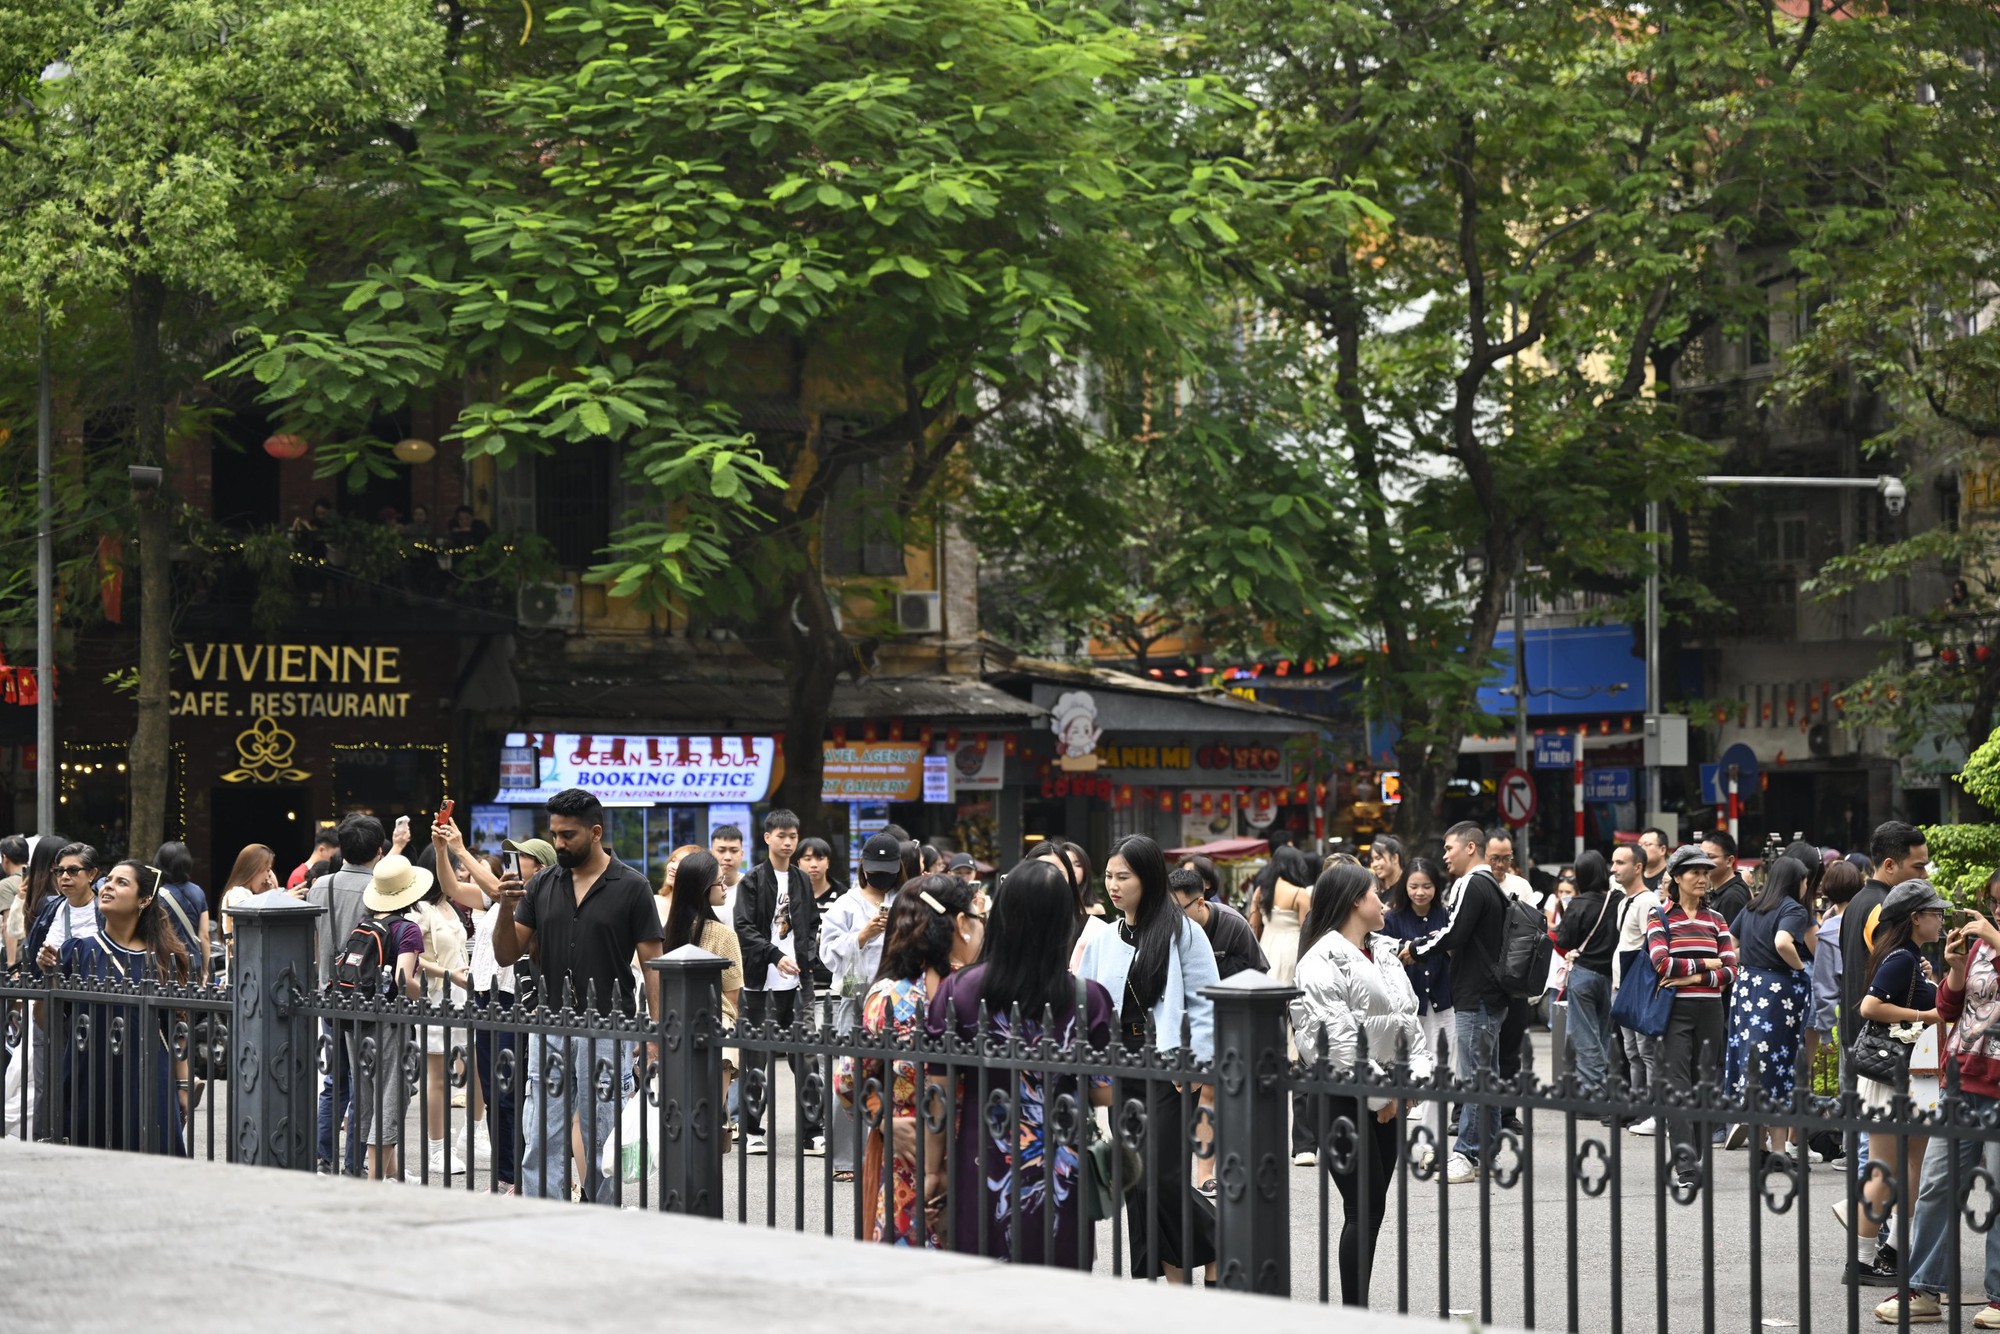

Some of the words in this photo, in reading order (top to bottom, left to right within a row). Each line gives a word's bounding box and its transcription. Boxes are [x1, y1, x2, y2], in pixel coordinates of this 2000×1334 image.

[183, 643, 401, 684] VIVIENNE
[168, 690, 229, 716] CAFE
[250, 692, 411, 718] RESTAURANT
[823, 748, 858, 763] AVEL
[860, 748, 921, 764] AGENCY
[576, 771, 676, 787] BOOKING
[682, 772, 756, 787] OFFICE
[822, 779, 841, 793] RT
[842, 779, 910, 793] GALLERY
[618, 789, 699, 798] INFORMATION
[703, 790, 747, 798] CENTER
